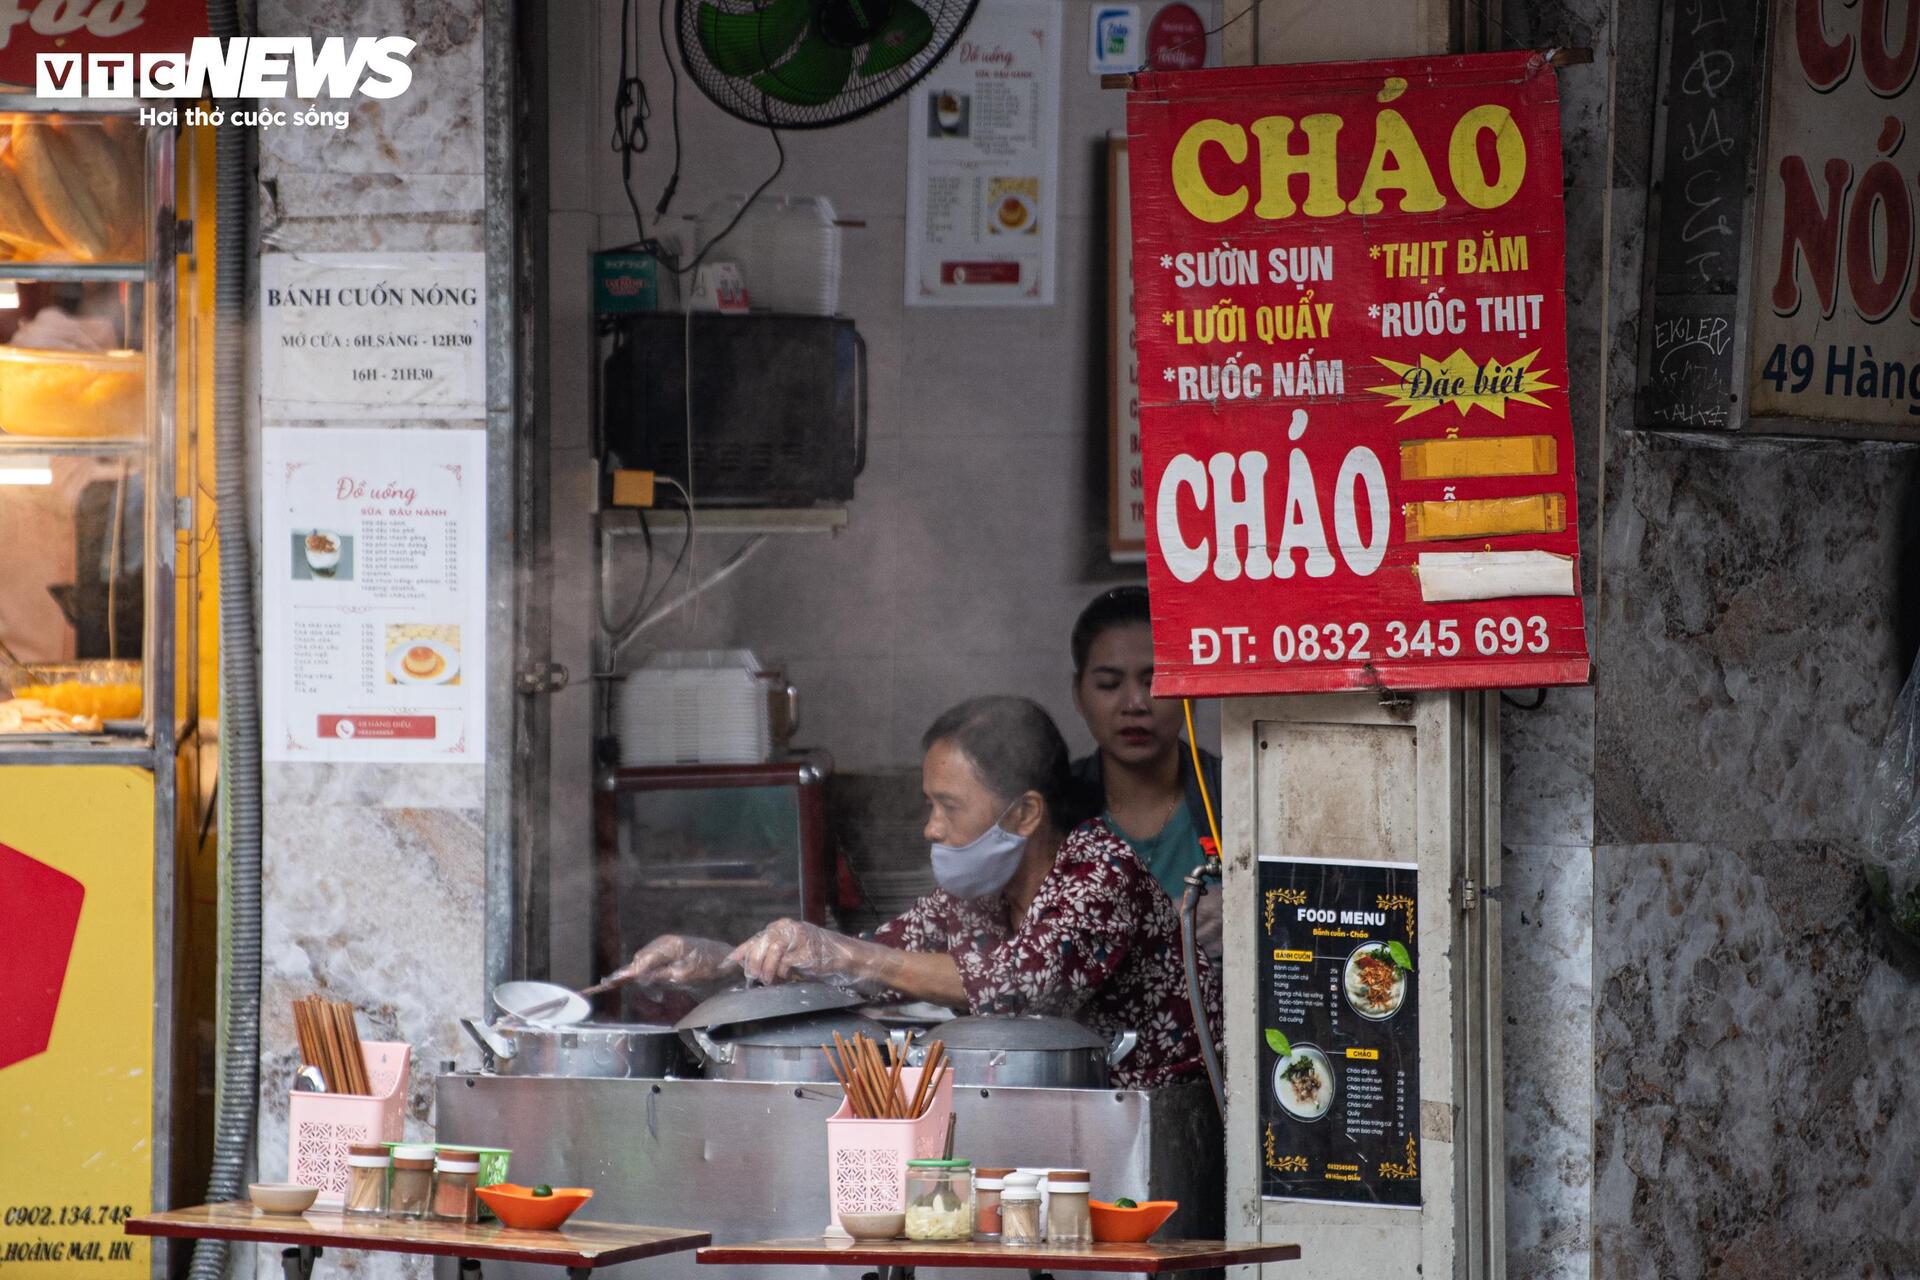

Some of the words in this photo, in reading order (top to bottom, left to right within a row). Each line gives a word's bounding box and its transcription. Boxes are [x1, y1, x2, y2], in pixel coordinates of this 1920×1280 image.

[1171, 77, 1527, 223] CHÁO
[1772, 116, 1920, 323] NÓ
[1269, 246, 1334, 290] SỤN
[1458, 230, 1529, 274] BĂM
[267, 284, 331, 306] BÁNH
[338, 281, 403, 306] CUỐN
[411, 282, 477, 306] NÓNG
[1256, 290, 1334, 342] QUẨY
[1476, 295, 1544, 338] THỊT
[281, 334, 306, 348] MỞ
[310, 334, 341, 348] CỬA
[352, 369, 377, 381] 16H
[1273, 348, 1345, 397] NẤM
[1763, 343, 1814, 395] 49
[336, 475, 367, 500] Đồ
[370, 481, 417, 505] uống
[1156, 408, 1391, 583] CHÁO
[1189, 627, 1256, 665] ĐT:
[1272, 623, 1371, 663] 0832
[1385, 619, 1461, 658] 345
[1474, 616, 1550, 654] 693
[1297, 908, 1336, 923] FOOD
[1340, 911, 1385, 926] MENU
[108, 1241, 134, 1260] HN
